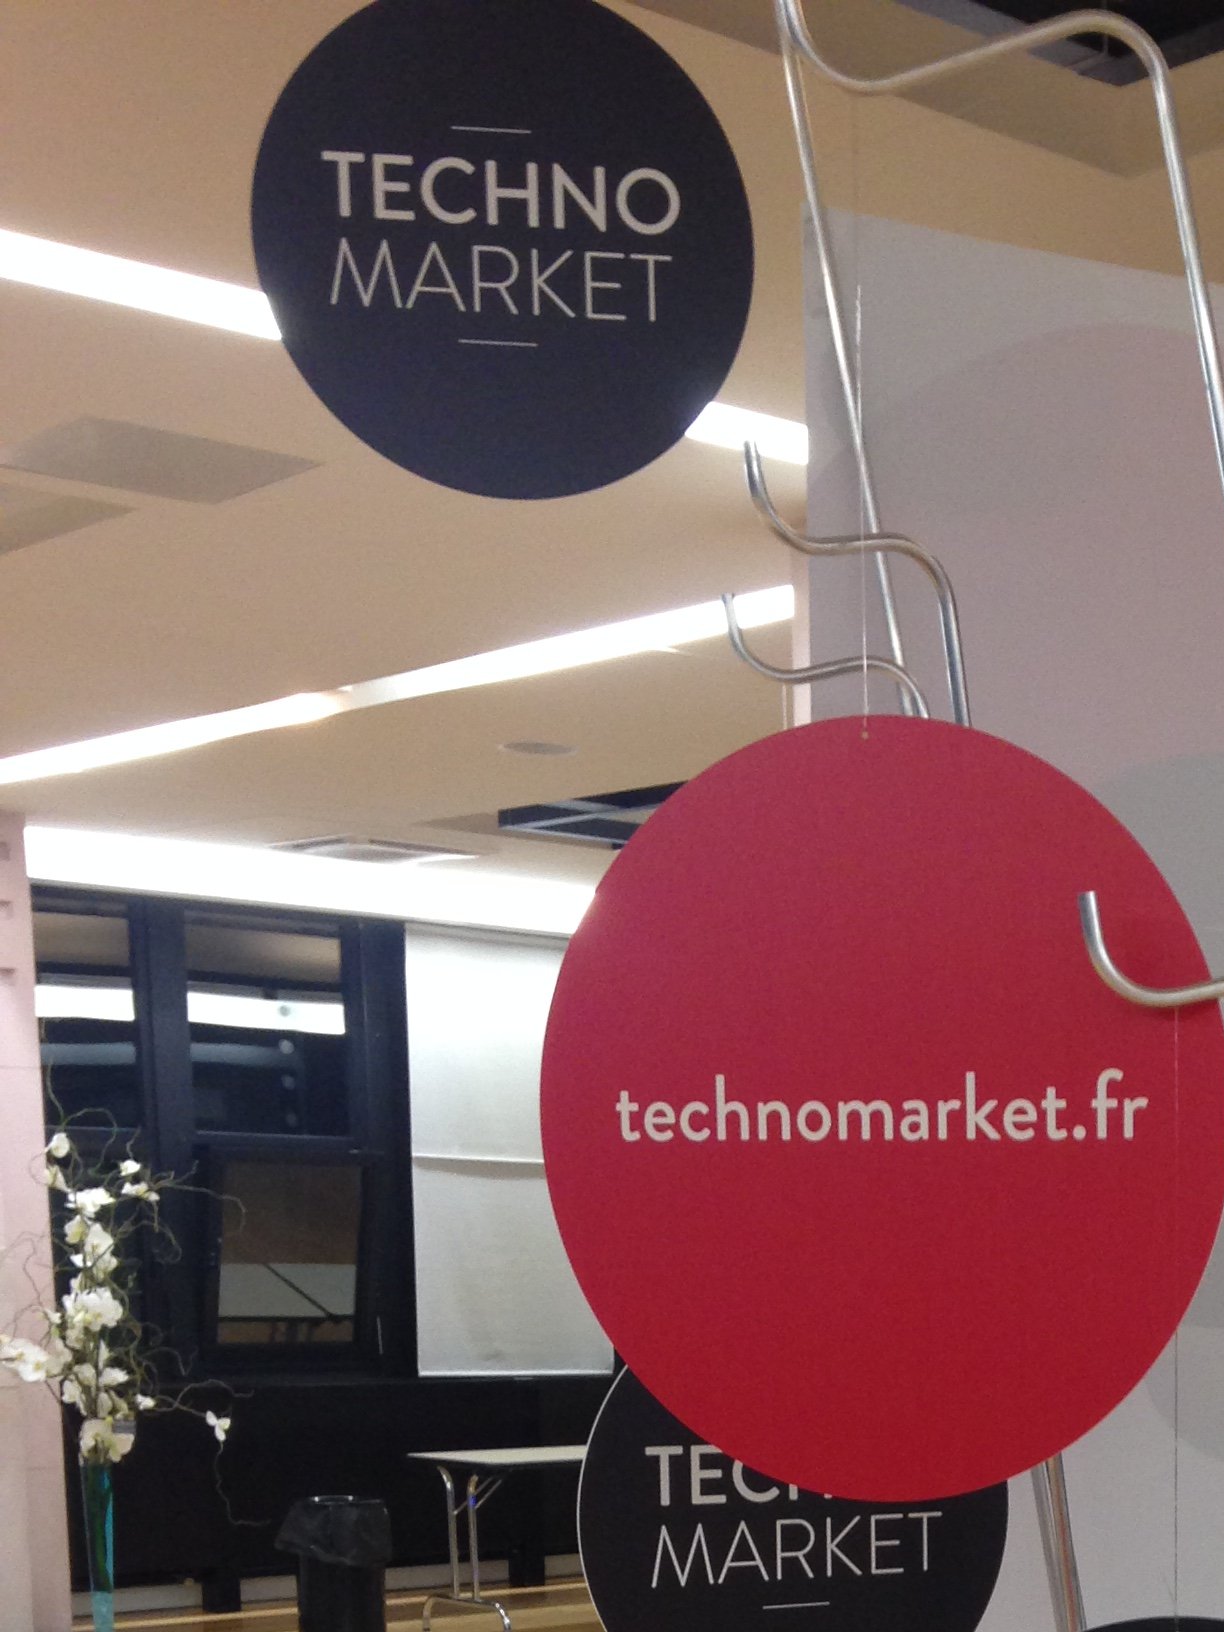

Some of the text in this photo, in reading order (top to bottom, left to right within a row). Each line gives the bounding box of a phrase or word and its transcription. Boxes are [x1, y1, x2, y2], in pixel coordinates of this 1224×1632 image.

[321, 149, 681, 236] TECHNO
[330, 236, 672, 322] MARKET
[615, 1067, 1149, 1143] technomarket.fr
[651, 1511, 943, 1588] MARKET
